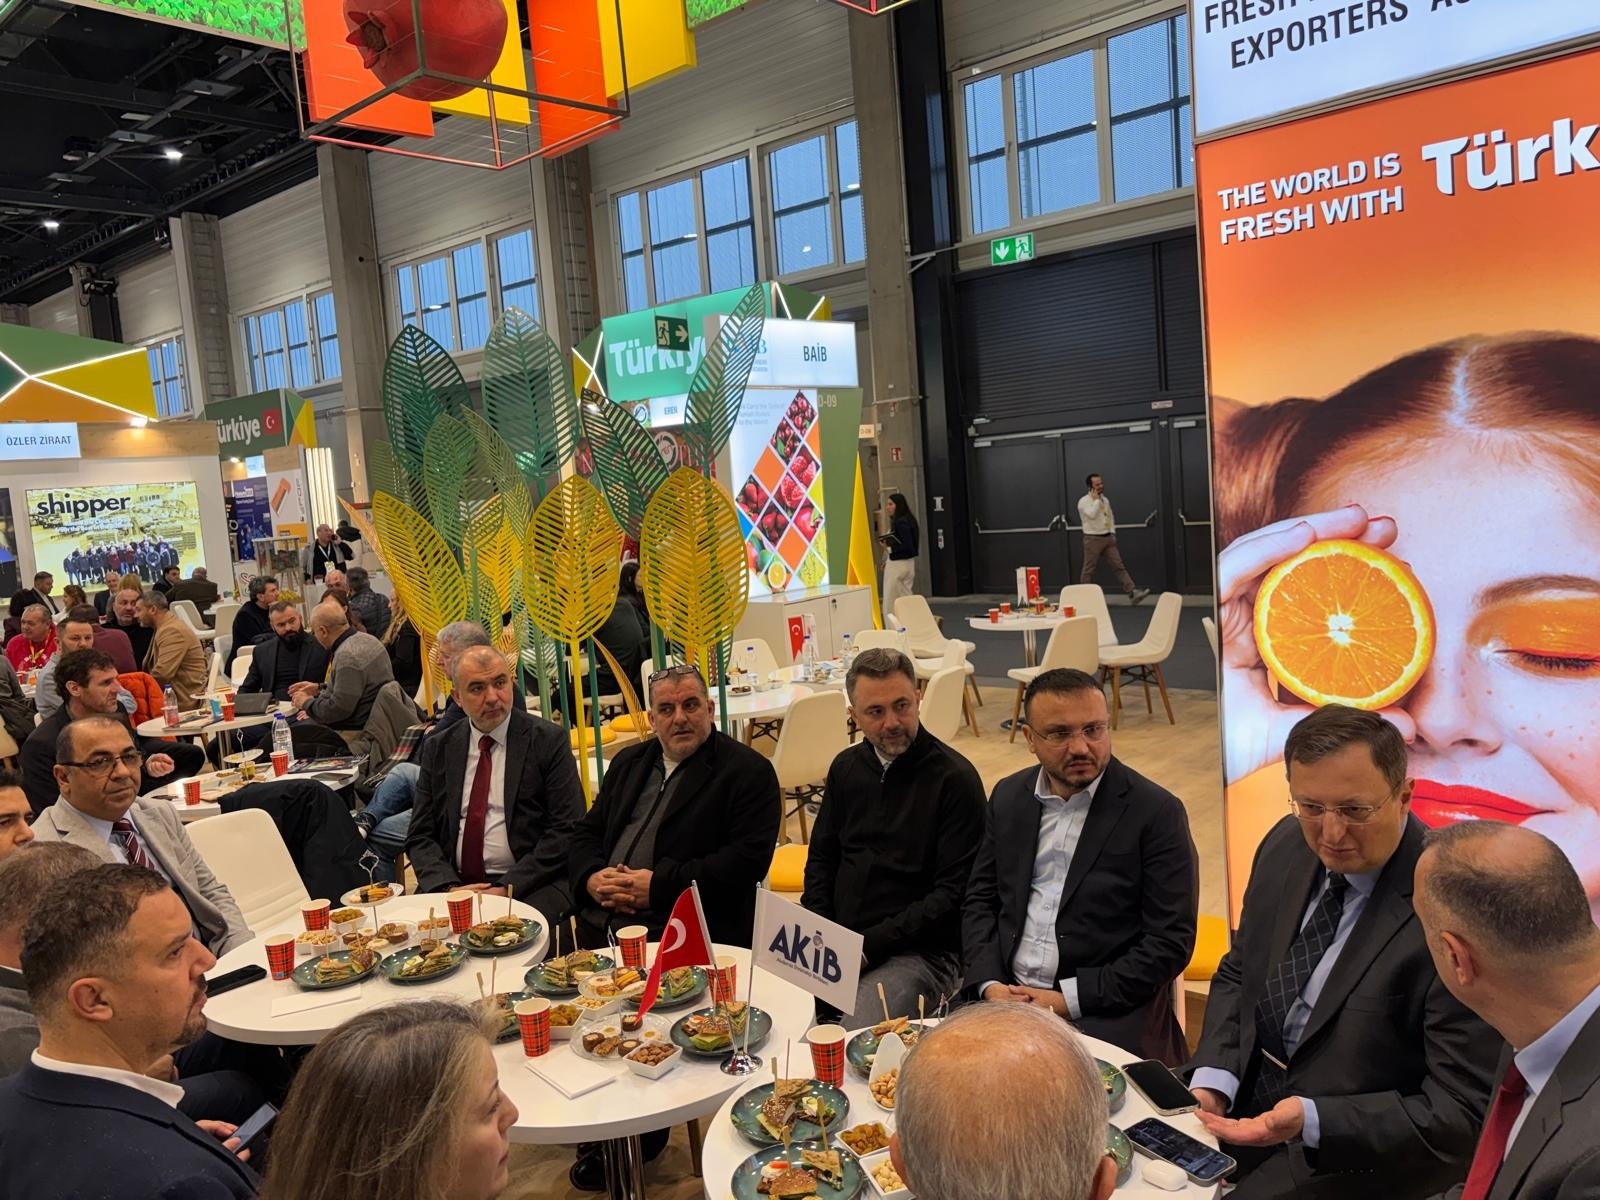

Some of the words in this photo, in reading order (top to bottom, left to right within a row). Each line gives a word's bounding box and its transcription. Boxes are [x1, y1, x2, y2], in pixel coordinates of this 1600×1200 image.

[1231, 0, 1408, 69] EXPORTERS
[1217, 181, 1266, 210] THE
[1270, 160, 1367, 200] WORLD
[1374, 152, 1401, 179] IS
[1421, 117, 1600, 196] Türk
[1220, 203, 1315, 245] FRESH
[1320, 185, 1404, 225] WITH
[217, 415, 261, 446] ürkiye
[37, 492, 131, 519] shipper
